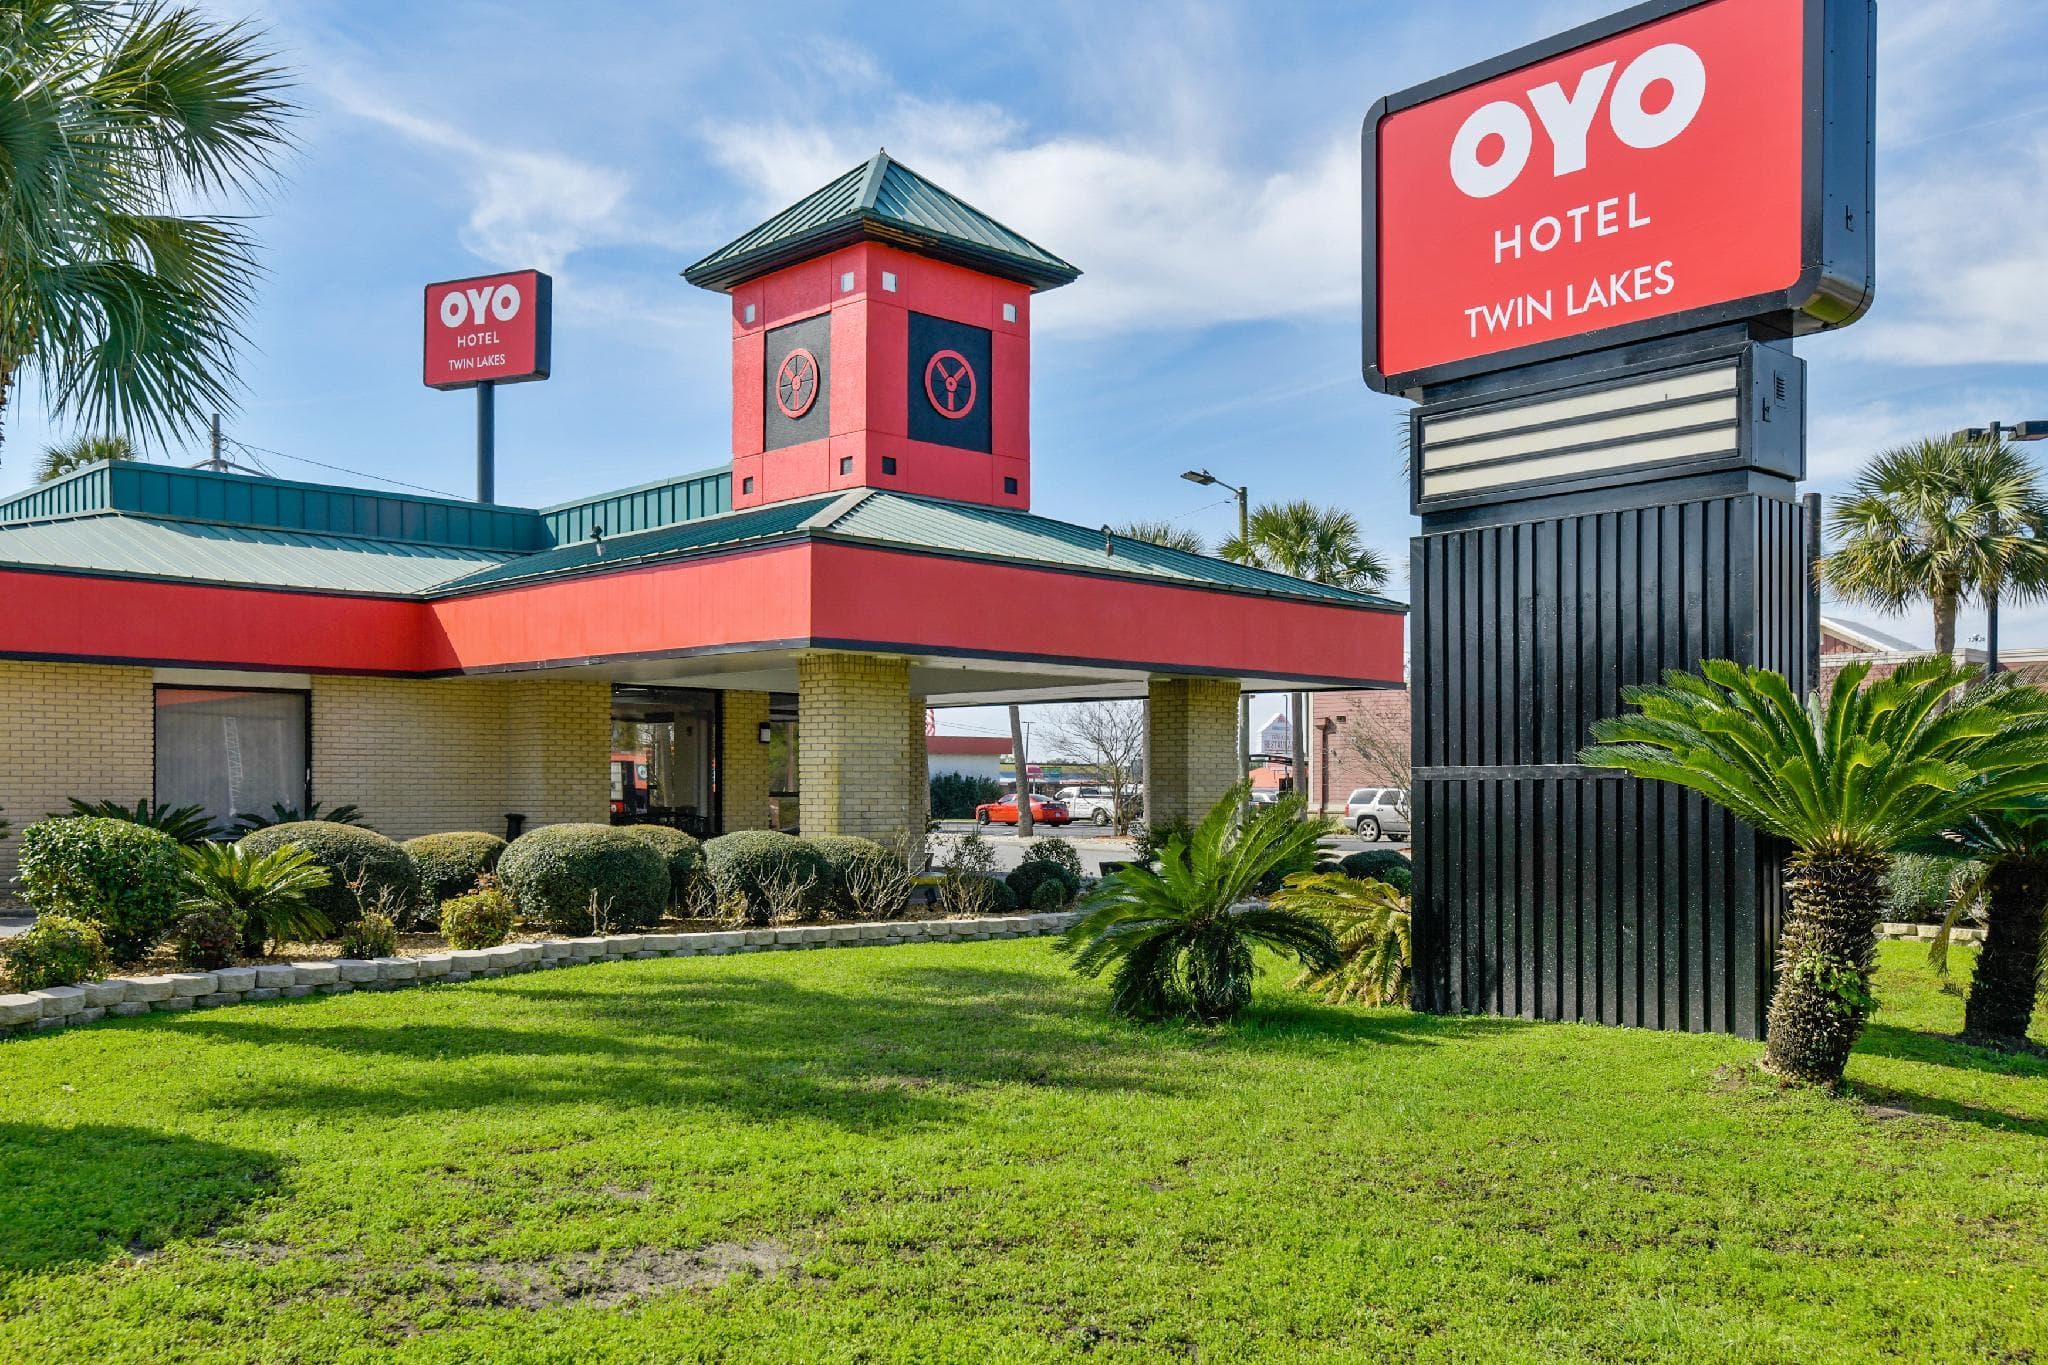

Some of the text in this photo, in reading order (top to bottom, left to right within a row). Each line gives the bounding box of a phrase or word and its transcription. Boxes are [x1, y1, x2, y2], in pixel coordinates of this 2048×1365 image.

[1449, 42, 1707, 199] OYO
[1494, 191, 1651, 264] HOTEL
[440, 283, 521, 328] OYO
[1464, 260, 1675, 338] TWIN LAKES
[448, 353, 506, 371] TWIN LAKES
[457, 331, 500, 348] HOTEL
